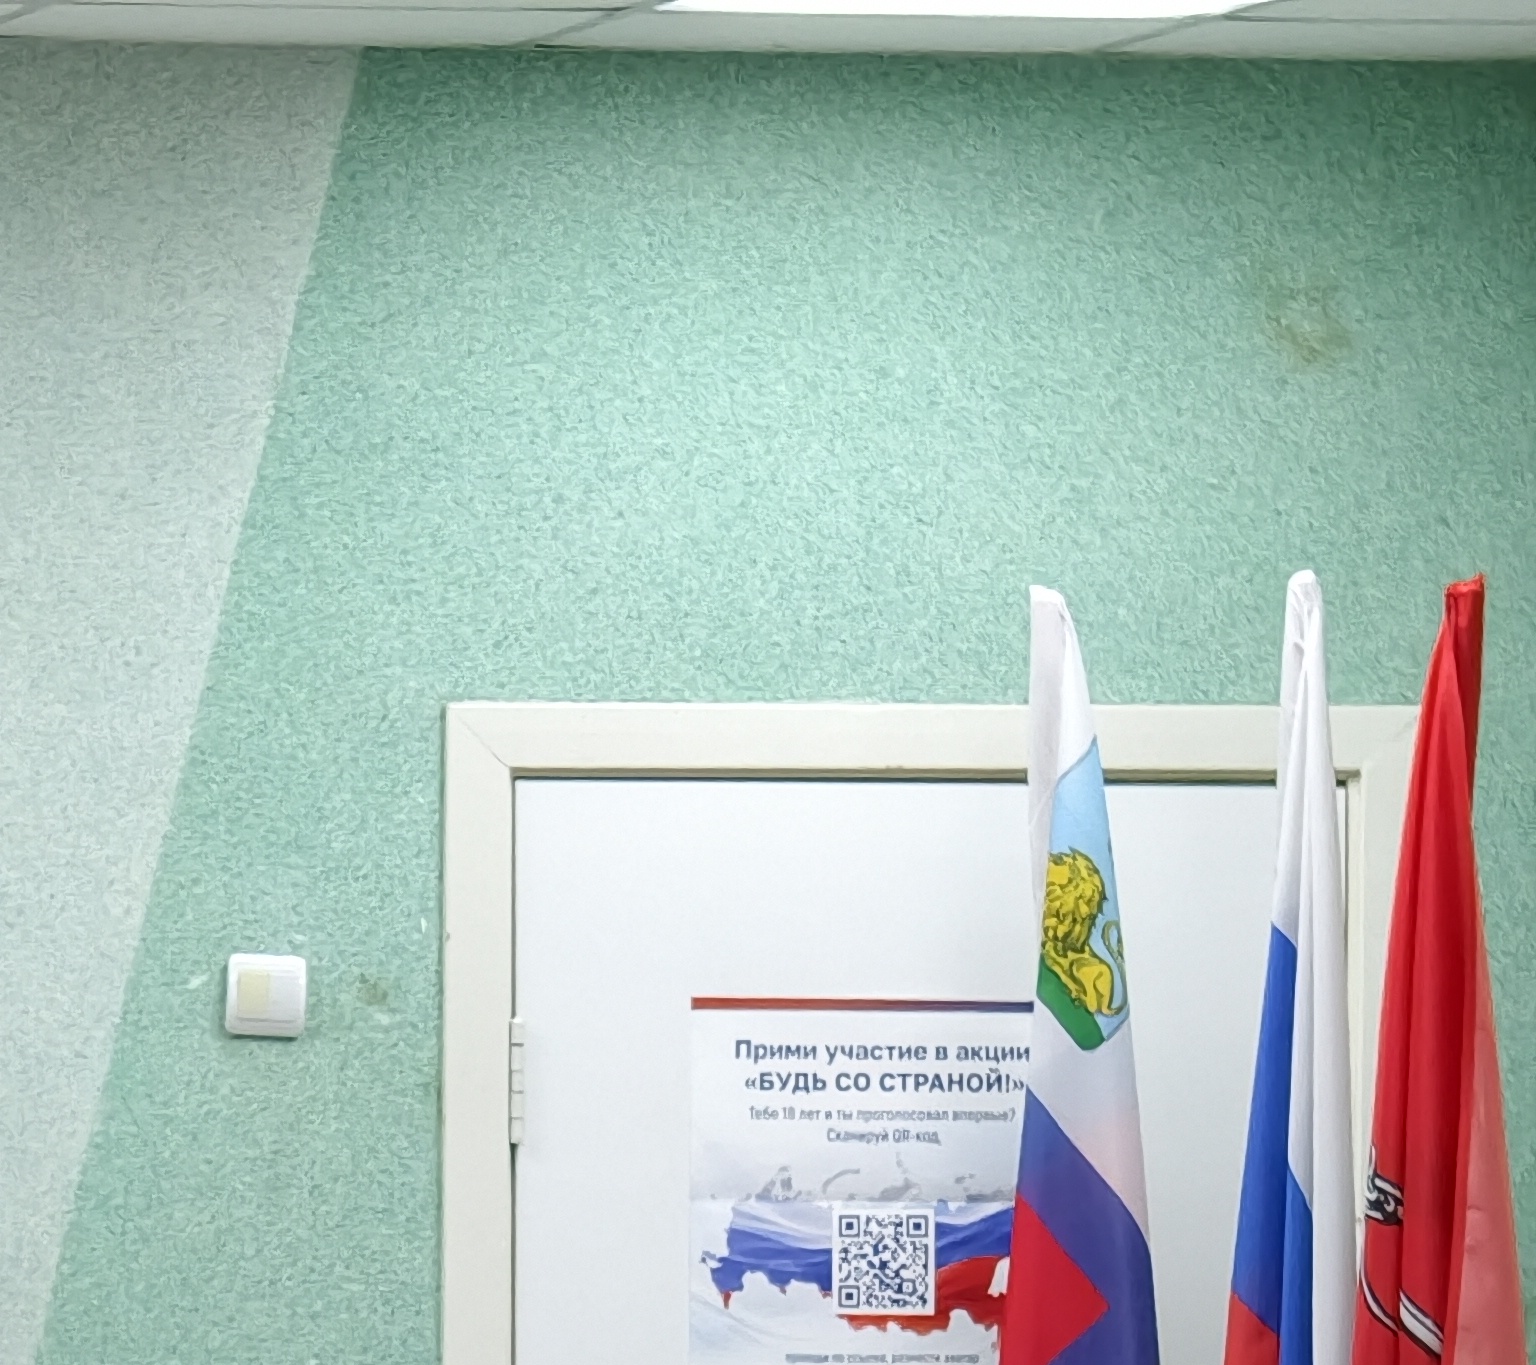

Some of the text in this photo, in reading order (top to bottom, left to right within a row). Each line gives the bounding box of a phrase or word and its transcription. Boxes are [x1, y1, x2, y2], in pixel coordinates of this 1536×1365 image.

[735, 1039, 1031, 1066] Прими участие в акции
[745, 1068, 1025, 1096] «БУДЬ СО СТРАНОЙ!»
